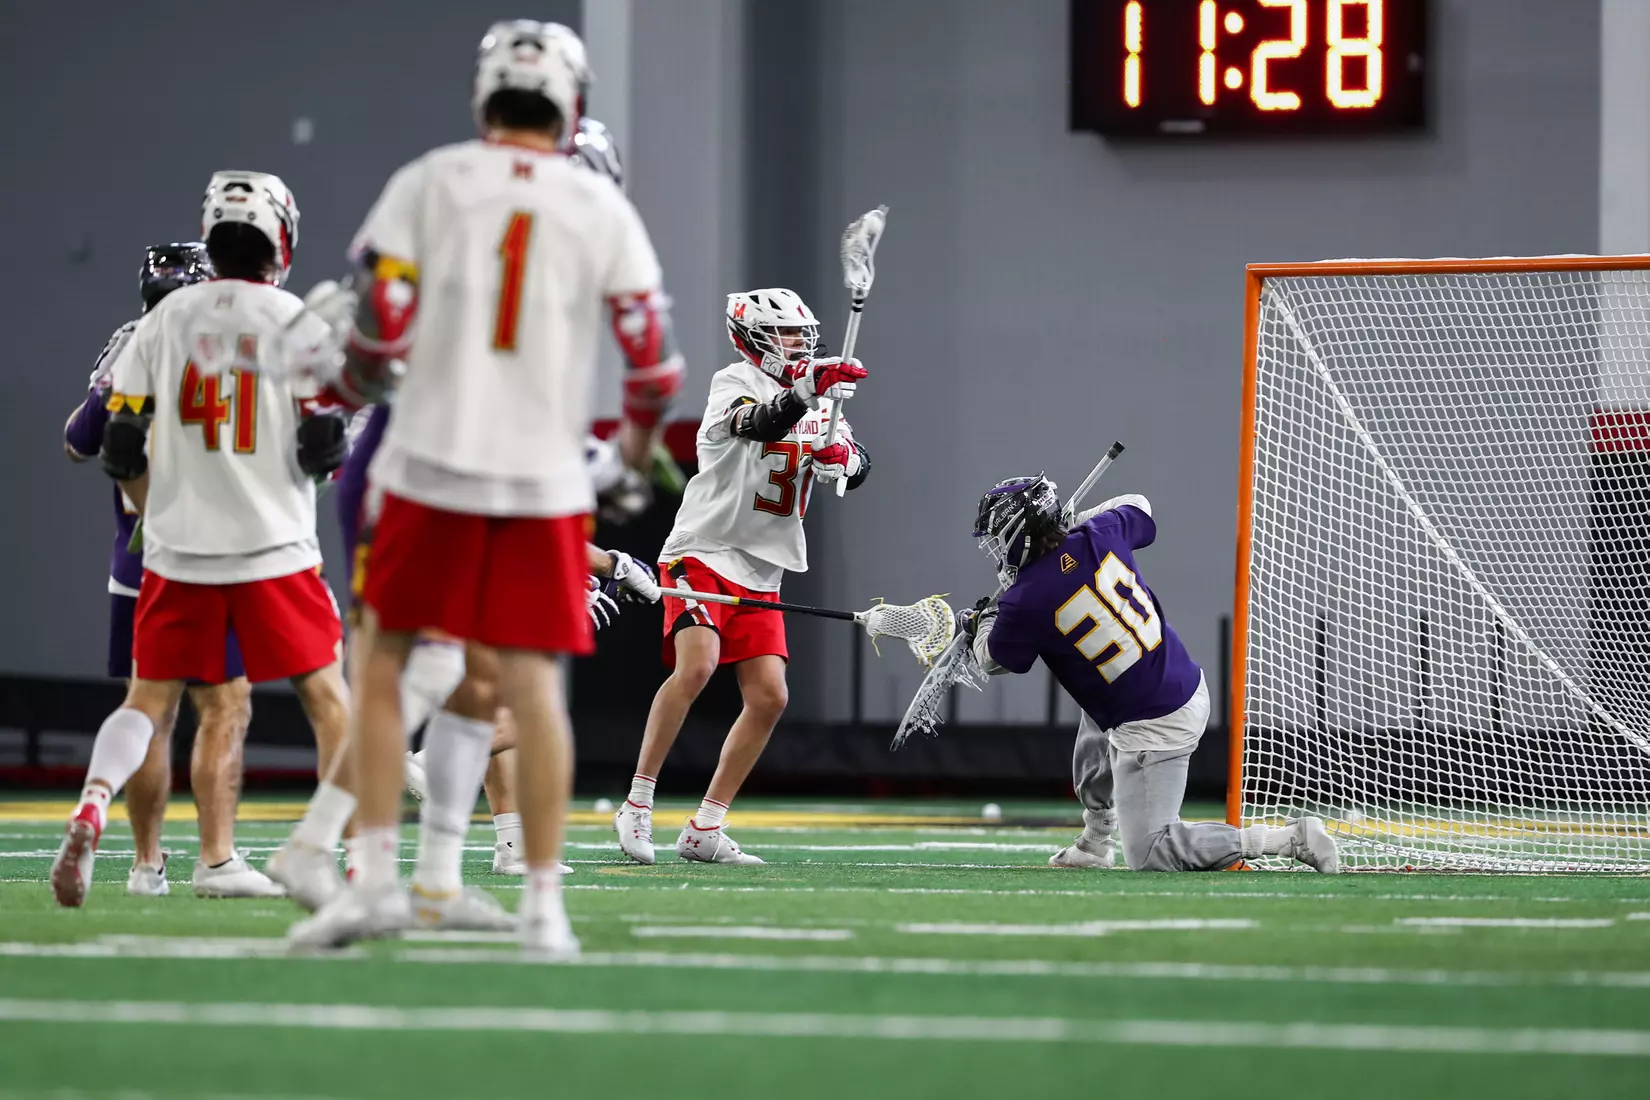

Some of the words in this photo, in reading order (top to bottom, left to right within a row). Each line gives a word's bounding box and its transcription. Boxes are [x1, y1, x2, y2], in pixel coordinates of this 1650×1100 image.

[1124, 0, 1383, 110] 11:28
[489, 210, 534, 352] 1
[178, 333, 259, 454] 41
[1054, 550, 1162, 685] 30
